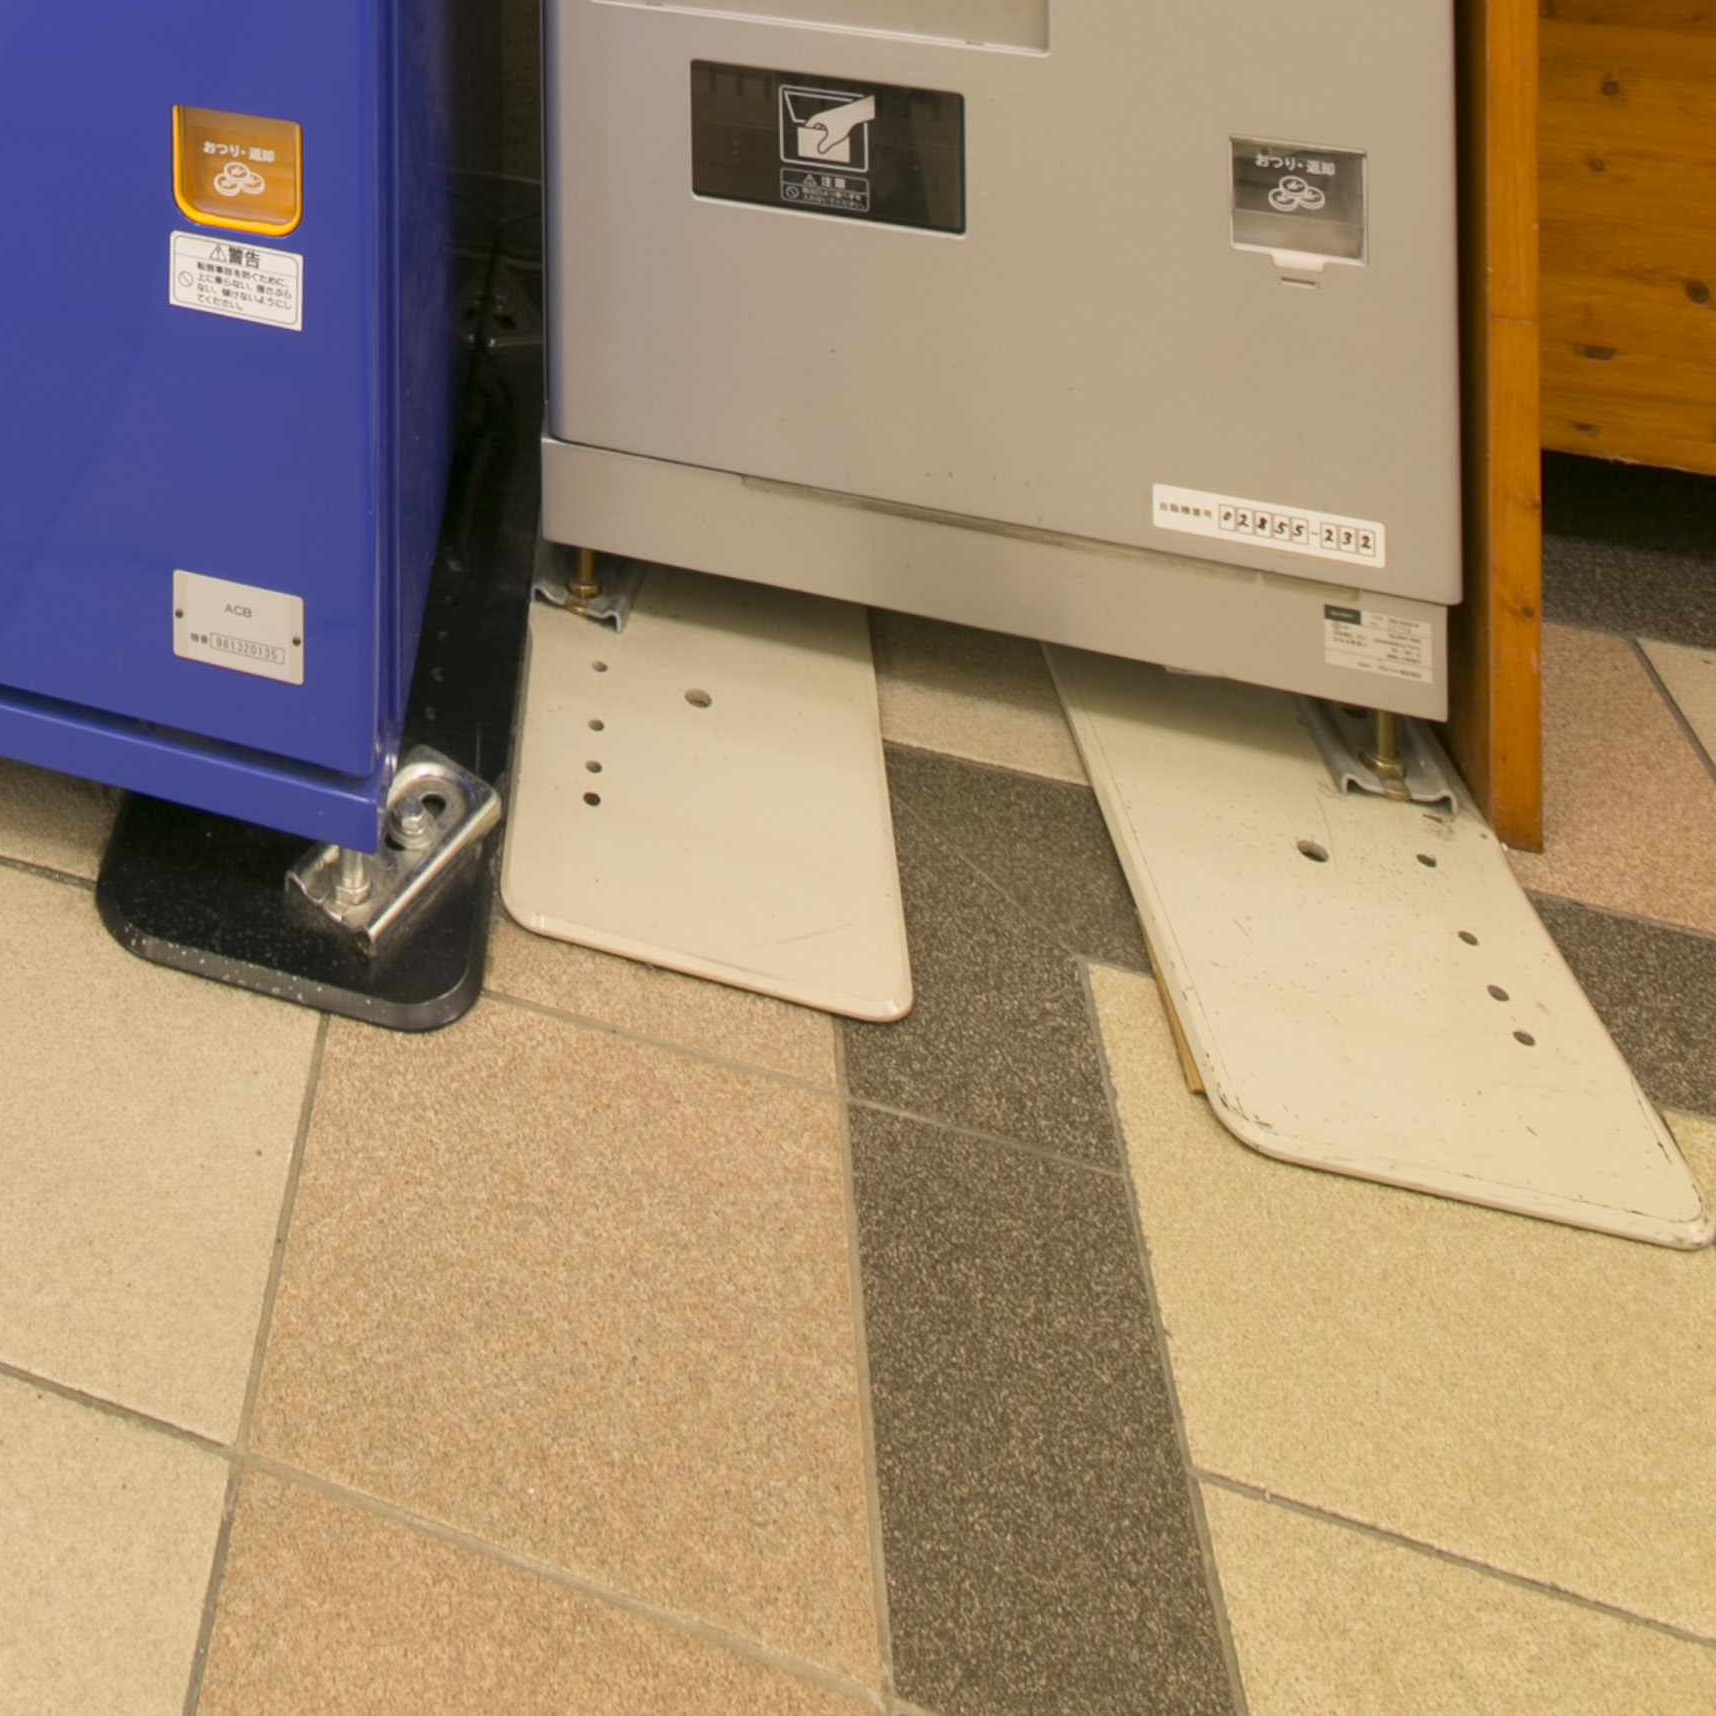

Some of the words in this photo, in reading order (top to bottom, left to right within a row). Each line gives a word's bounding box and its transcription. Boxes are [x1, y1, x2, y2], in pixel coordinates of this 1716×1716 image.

[203, 141, 275, 162] おつり・返却
[1255, 154, 1336, 176] おつり・返却
[229, 246, 260, 269] 警告
[225, 604, 252, 617] ACB
[216, 637, 277, 660] 981320135
